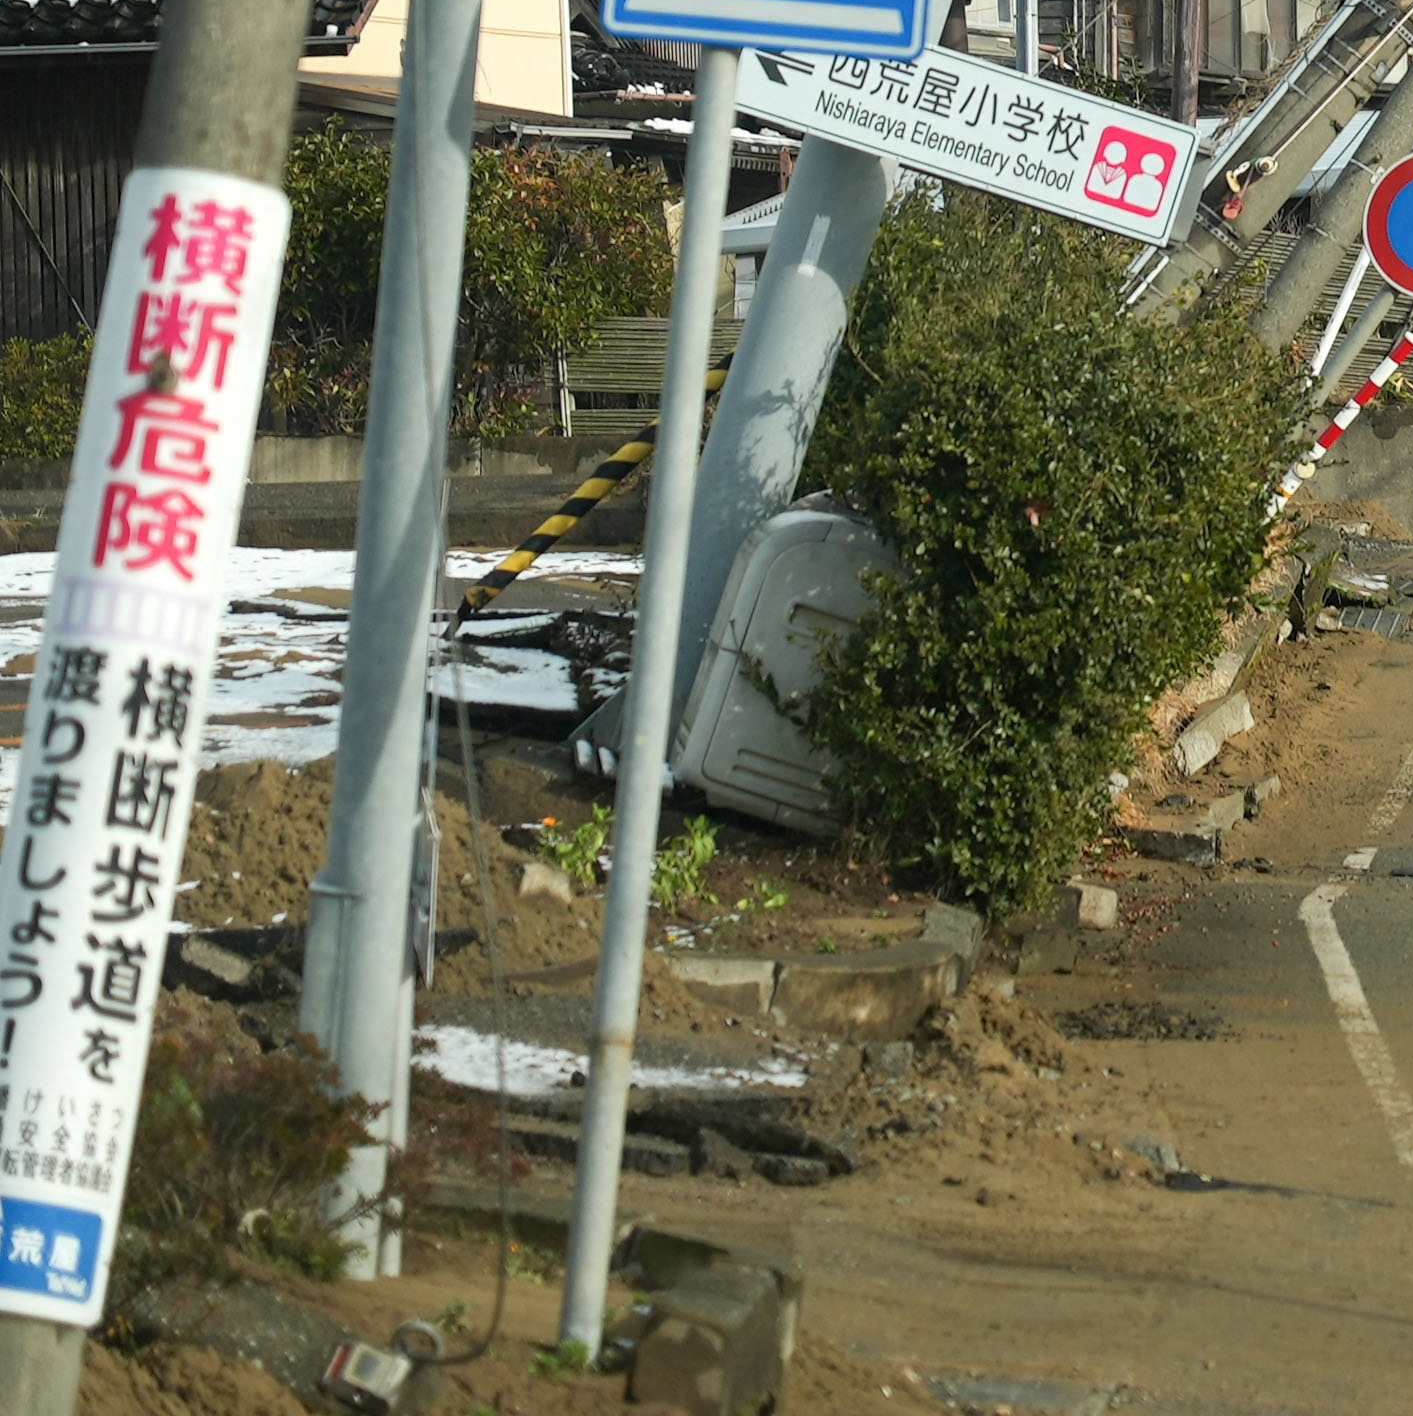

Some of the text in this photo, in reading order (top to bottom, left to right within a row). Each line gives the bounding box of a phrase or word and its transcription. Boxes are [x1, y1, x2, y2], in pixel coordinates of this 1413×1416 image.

[815, 91, 1076, 192] Nishiaraya Elementary School
[826, 50, 1090, 162] 西荒屋小学校
[92, 194, 255, 582] 横断危険
[72, 655, 194, 1084] 横断歩道を
[0, 1115, 118, 1163] 安全協会
[0, 1220, 81, 1273] 荒屋
